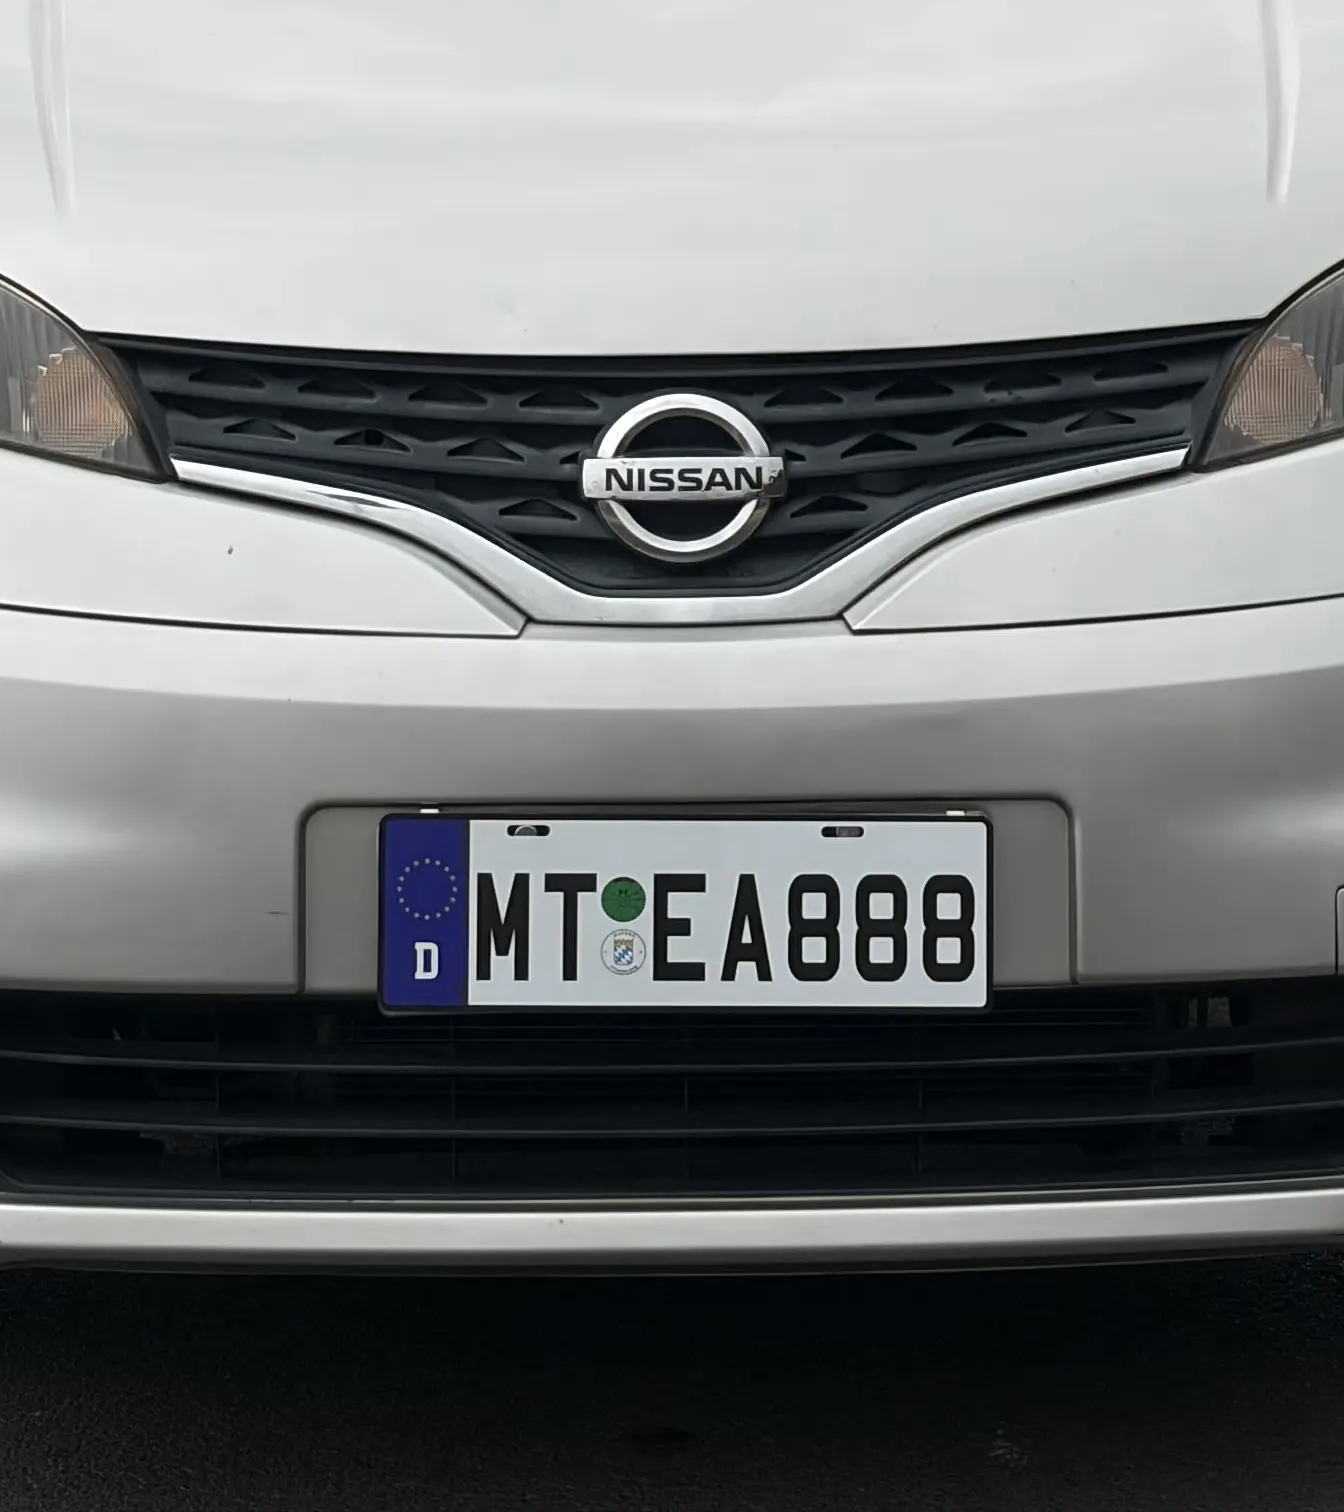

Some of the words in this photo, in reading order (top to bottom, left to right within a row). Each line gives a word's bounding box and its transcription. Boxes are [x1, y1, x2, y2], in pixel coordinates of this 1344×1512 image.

[605, 466, 763, 492] NISSAN
[652, 872, 976, 982] EA888
[414, 942, 439, 980] D
